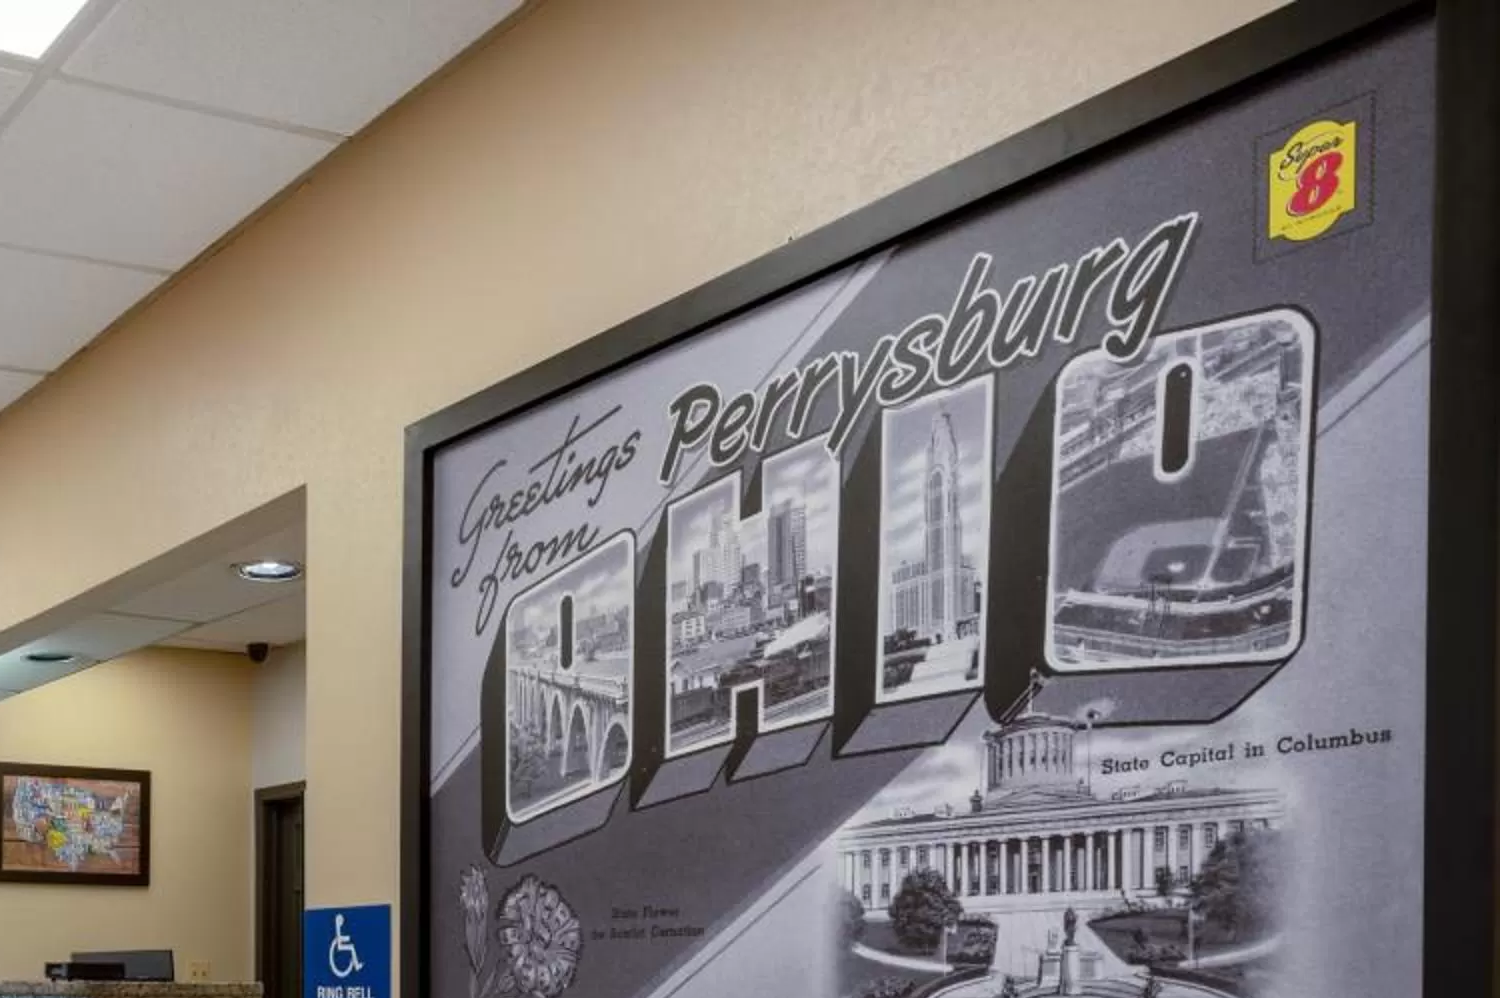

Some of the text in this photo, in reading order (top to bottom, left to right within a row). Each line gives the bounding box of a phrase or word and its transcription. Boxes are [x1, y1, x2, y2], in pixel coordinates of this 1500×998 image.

[1278, 136, 1343, 180] Super
[1285, 151, 1344, 217] 8
[658, 211, 1198, 487] Perrysburg
[451, 403, 641, 588] Greetings
[475, 522, 599, 636] from
[503, 305, 1317, 826] OHIO
[1100, 727, 1392, 775] State Capital in Columbus
